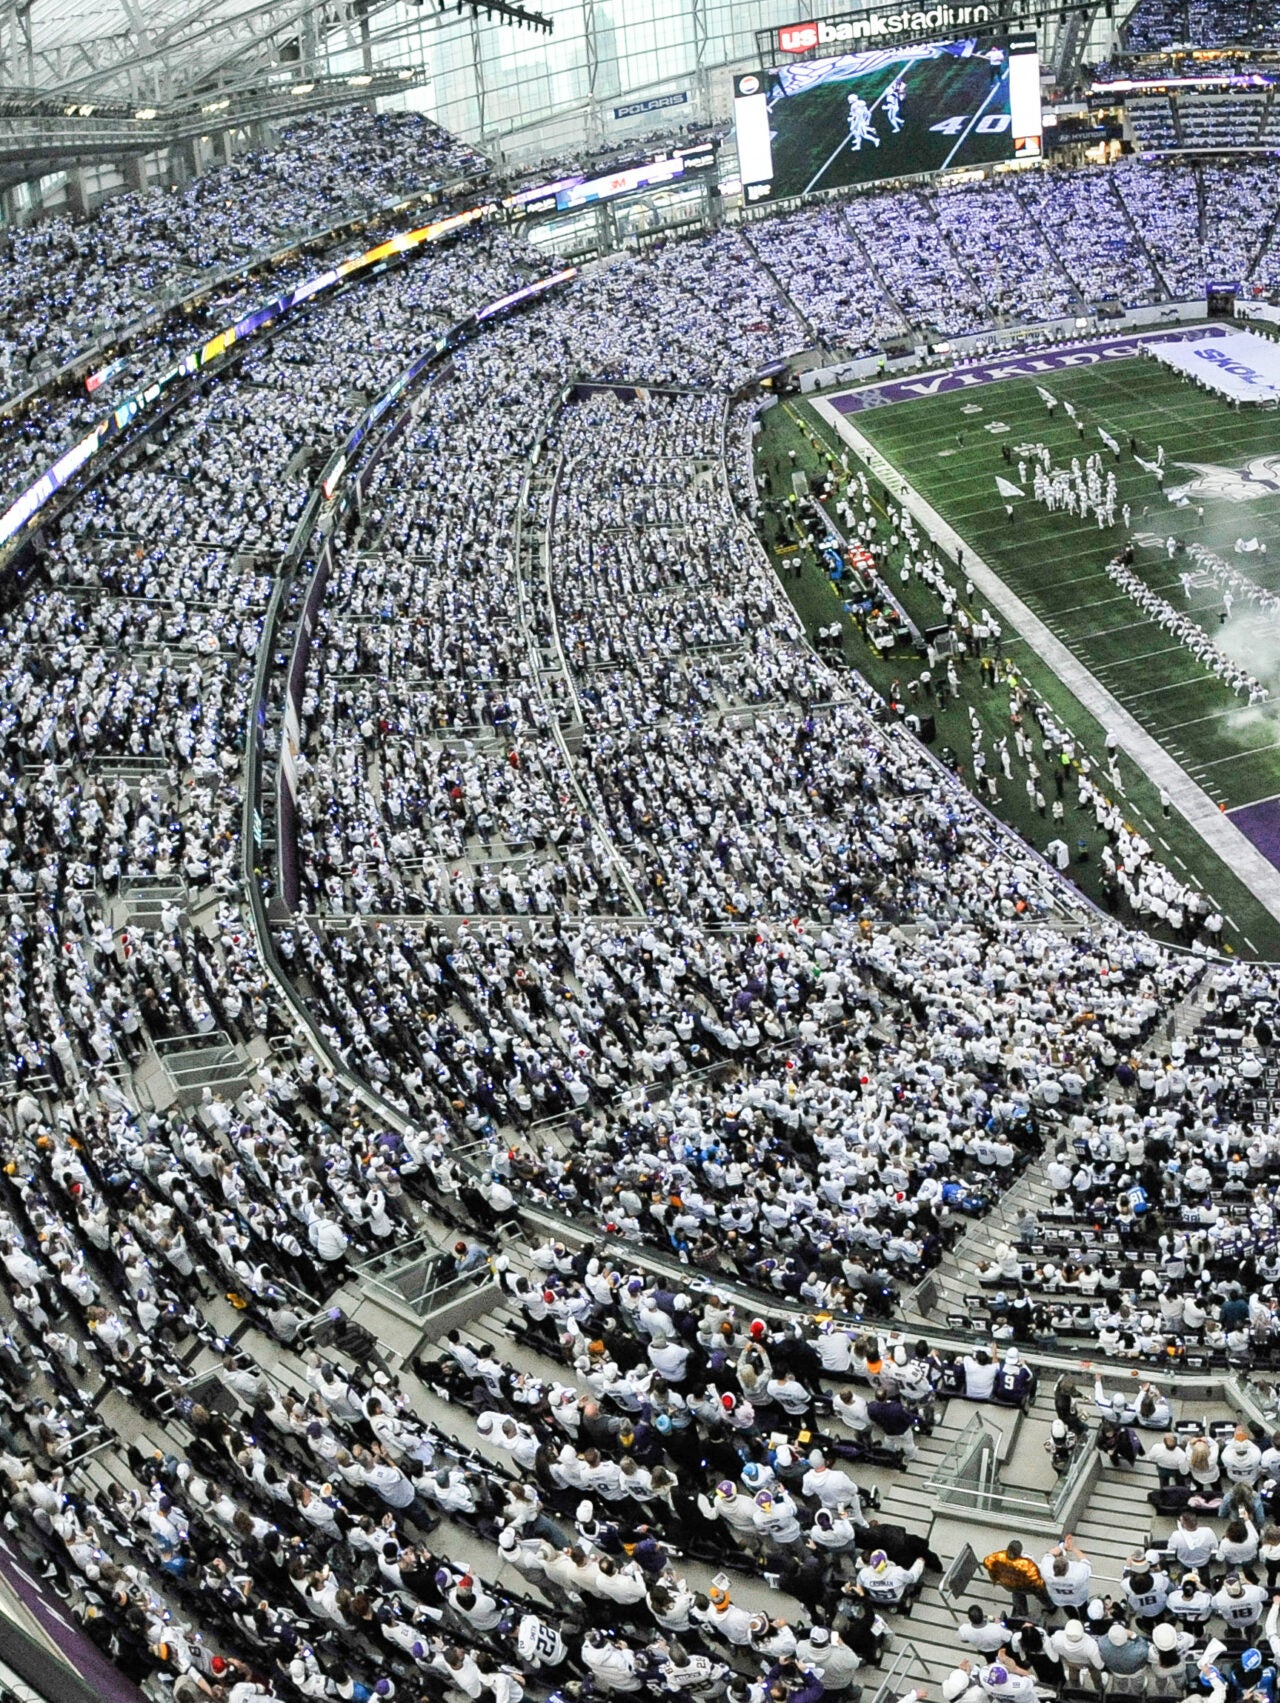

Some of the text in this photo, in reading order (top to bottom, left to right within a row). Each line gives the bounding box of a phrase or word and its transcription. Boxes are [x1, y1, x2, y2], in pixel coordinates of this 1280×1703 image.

[618, 94, 684, 118] POLARIS
[899, 343, 1138, 395] VIKING
[1194, 348, 1263, 386] SKOL
[1004, 1375, 1014, 1390] 9
[1138, 1596, 1157, 1606] 18
[1231, 1608, 1251, 1619] 18
[536, 1623, 557, 1658] 22
